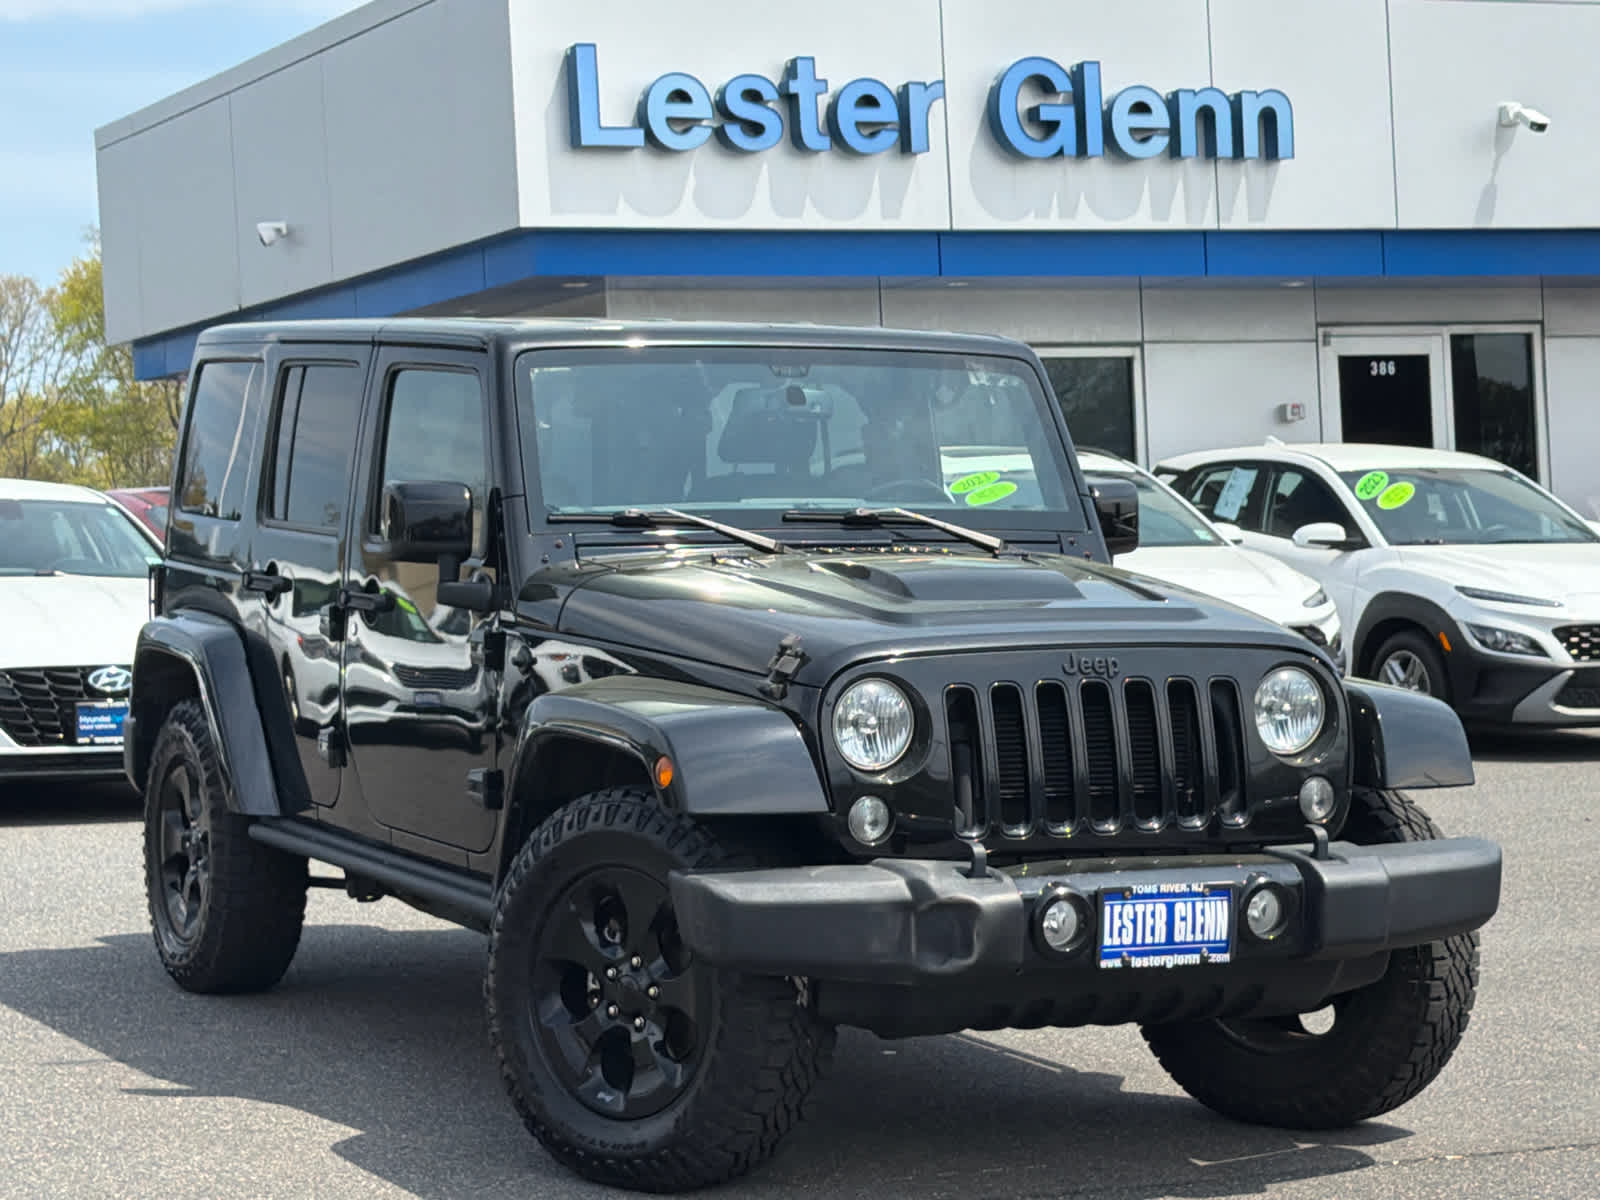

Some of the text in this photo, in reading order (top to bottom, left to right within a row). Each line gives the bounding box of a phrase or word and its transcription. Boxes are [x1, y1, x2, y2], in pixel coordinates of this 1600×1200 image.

[566, 42, 1295, 161] Lester Glenn
[1370, 361, 1395, 376] 386
[1062, 652, 1120, 679] Jeep
[1131, 884, 1158, 895] TOMS
[1103, 900, 1229, 946] LESTER GLENN
[1131, 953, 1200, 968] lesterglenn
